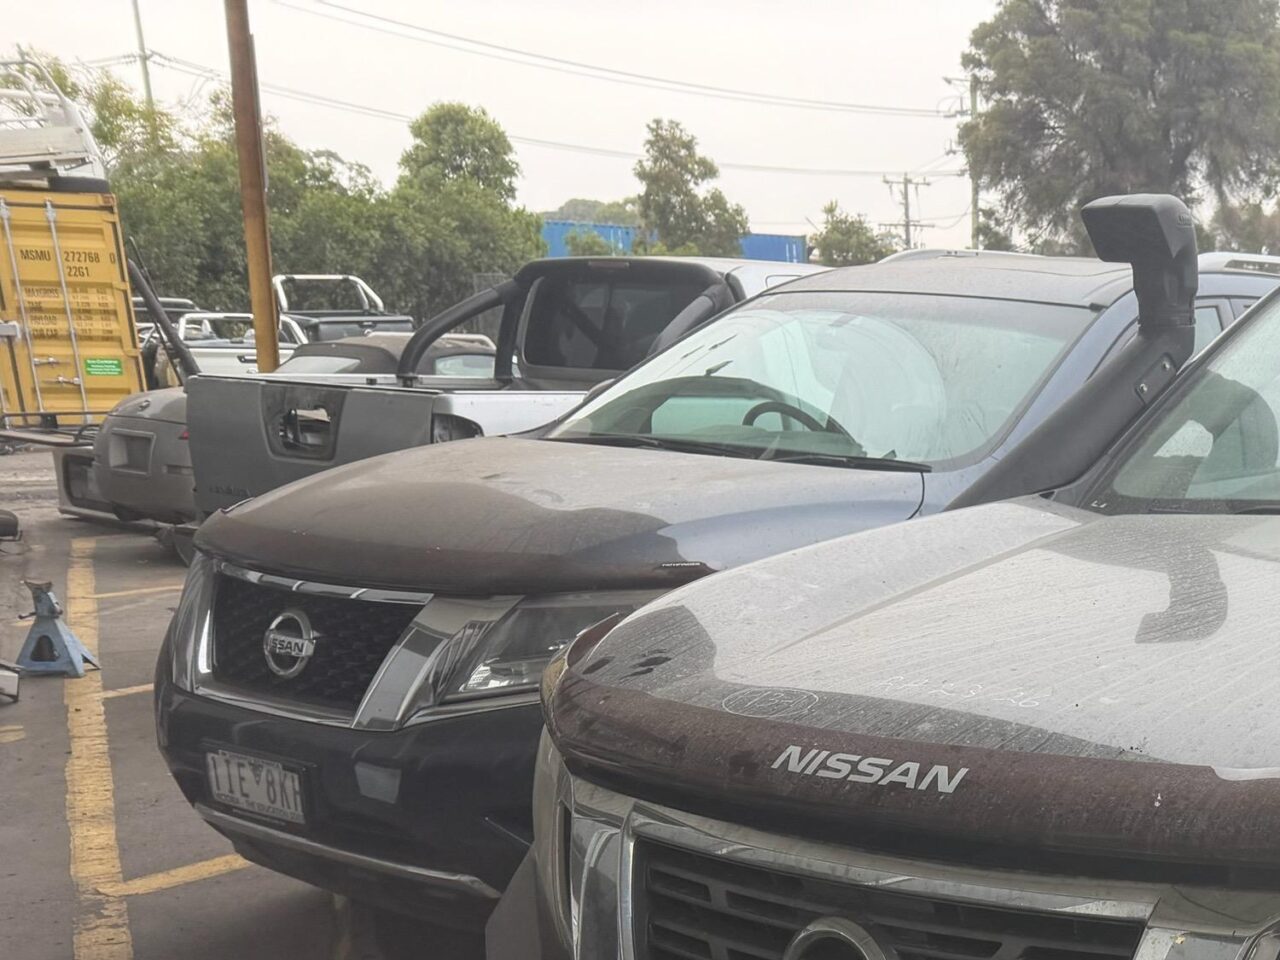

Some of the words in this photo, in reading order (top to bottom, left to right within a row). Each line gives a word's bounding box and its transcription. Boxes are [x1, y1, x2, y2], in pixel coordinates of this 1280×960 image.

[20, 250, 51, 262] MSMU
[64, 251, 100, 264] 272768
[66, 266, 90, 277] 22G1
[270, 638, 304, 653] SSAN
[770, 744, 970, 794] NISSAN
